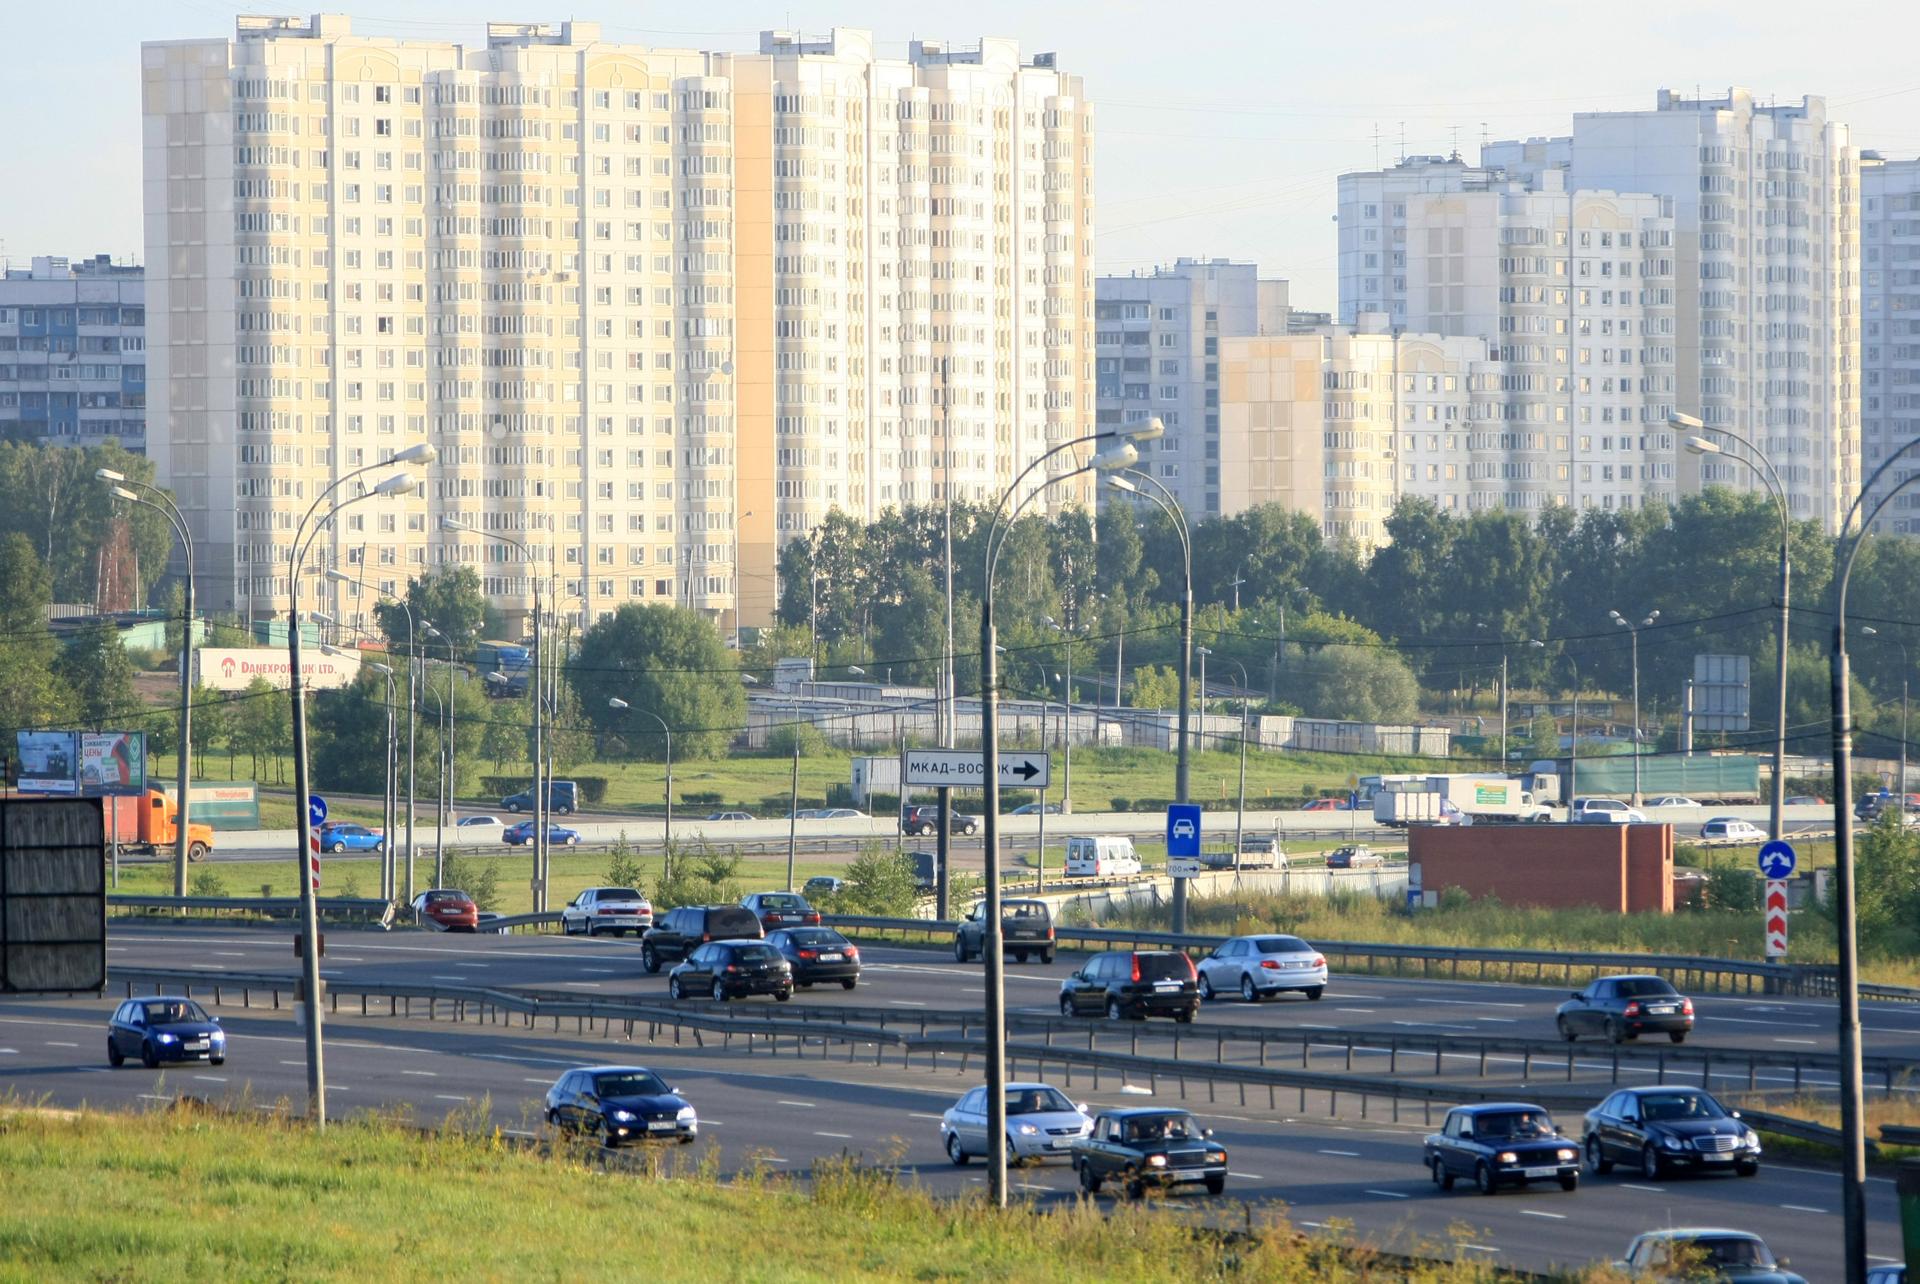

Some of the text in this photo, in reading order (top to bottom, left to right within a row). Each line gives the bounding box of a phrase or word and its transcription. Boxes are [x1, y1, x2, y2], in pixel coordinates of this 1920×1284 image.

[241, 661, 296, 674] DANEXPOR
[318, 664, 337, 674] LTD.
[84, 748, 102, 757] ЦЕНЫ
[910, 762, 1009, 774] МКАД-ВОСК
